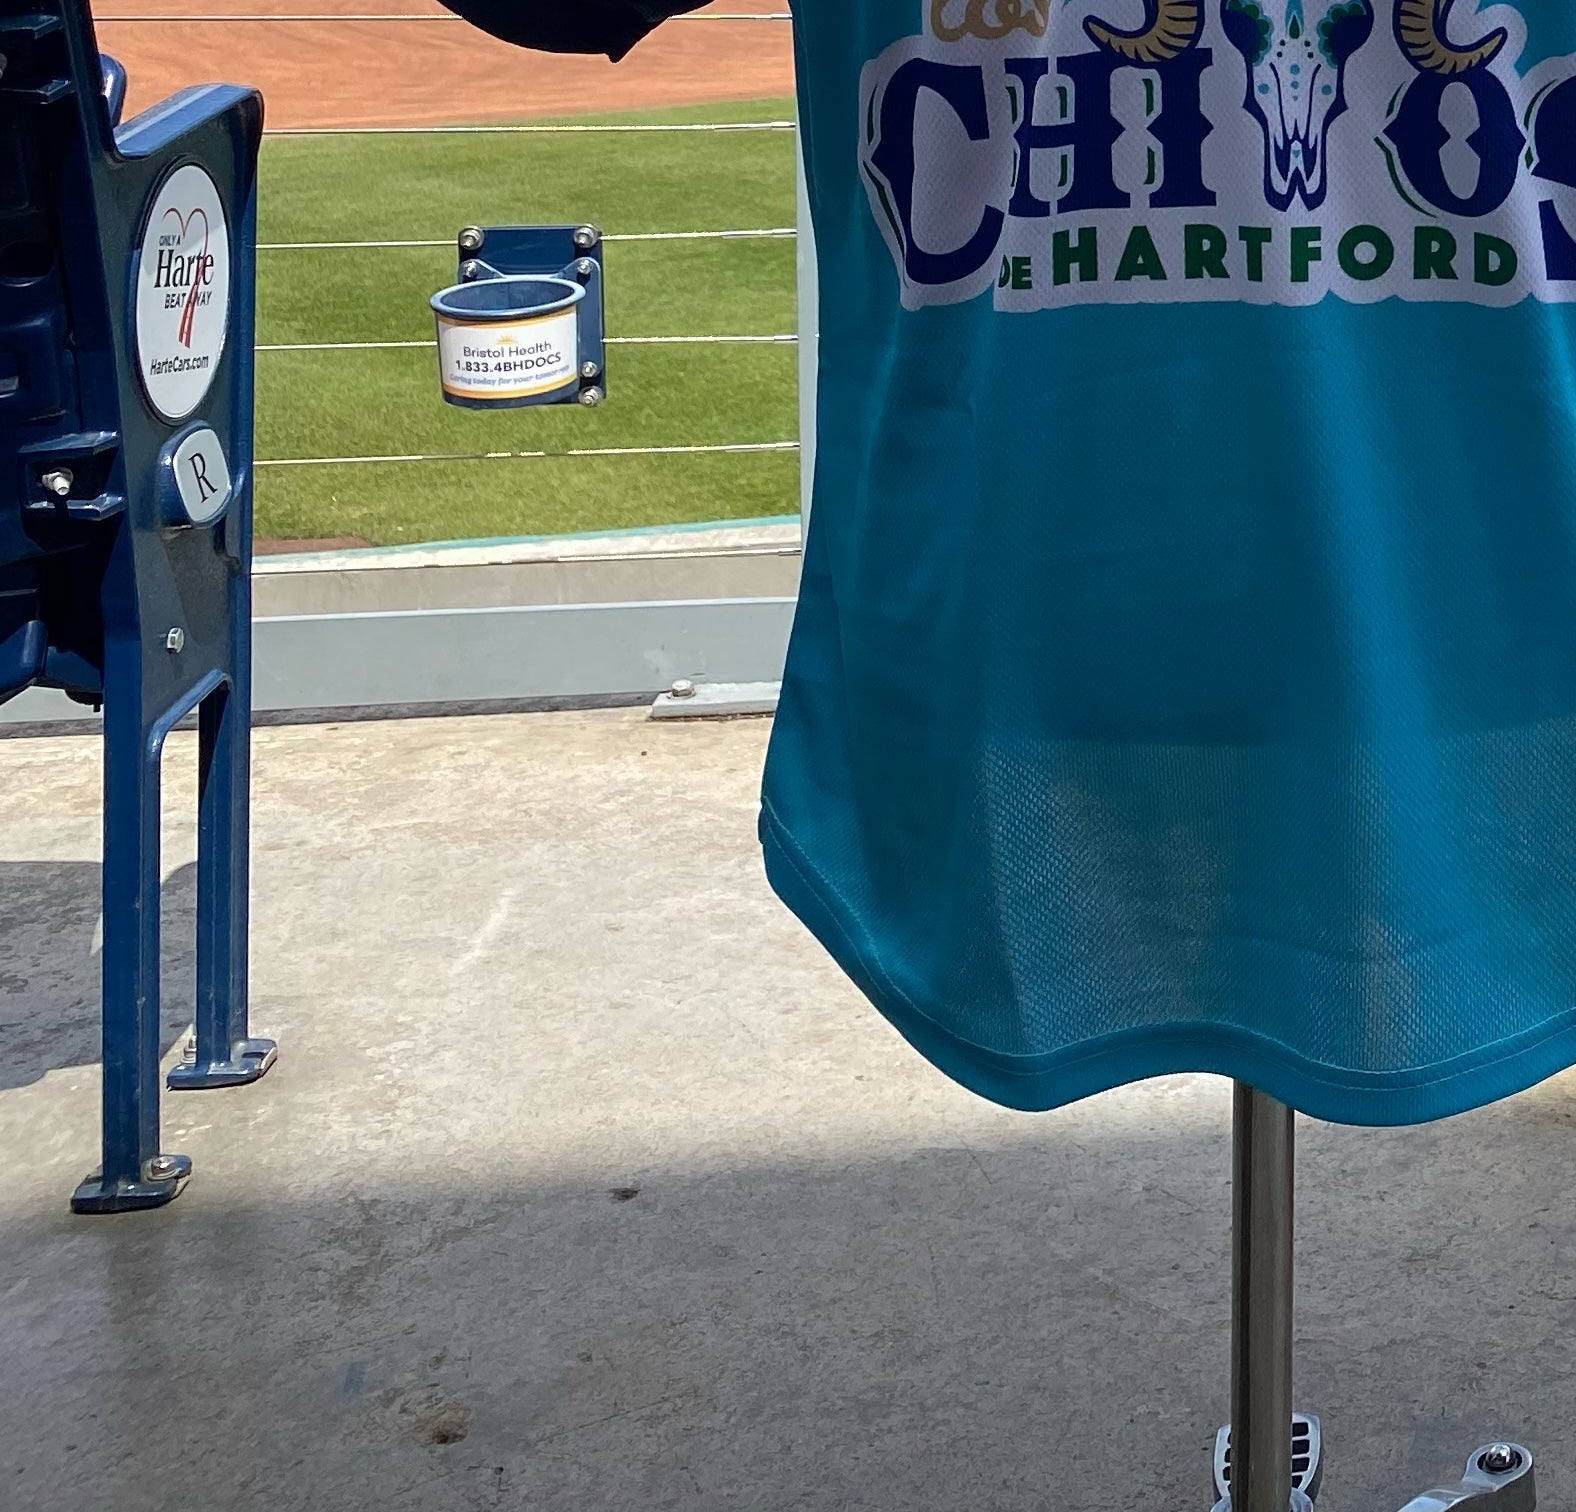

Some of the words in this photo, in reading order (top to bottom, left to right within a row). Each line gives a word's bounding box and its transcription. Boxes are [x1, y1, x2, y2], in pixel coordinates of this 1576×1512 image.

[158, 235, 177, 247] ONLY
[1052, 222, 1519, 288] HARTFORD
[154, 247, 215, 289] Harte
[164, 292, 188, 309] BEAT
[463, 346, 505, 359] Bristol
[508, 341, 552, 358] Health
[150, 355, 209, 376] HarteCars.com
[455, 351, 561, 373] 1.833.4BHDOCS
[473, 376, 497, 386] today
[498, 377, 511, 386] for
[513, 375, 533, 385] your
[188, 453, 218, 504] R
